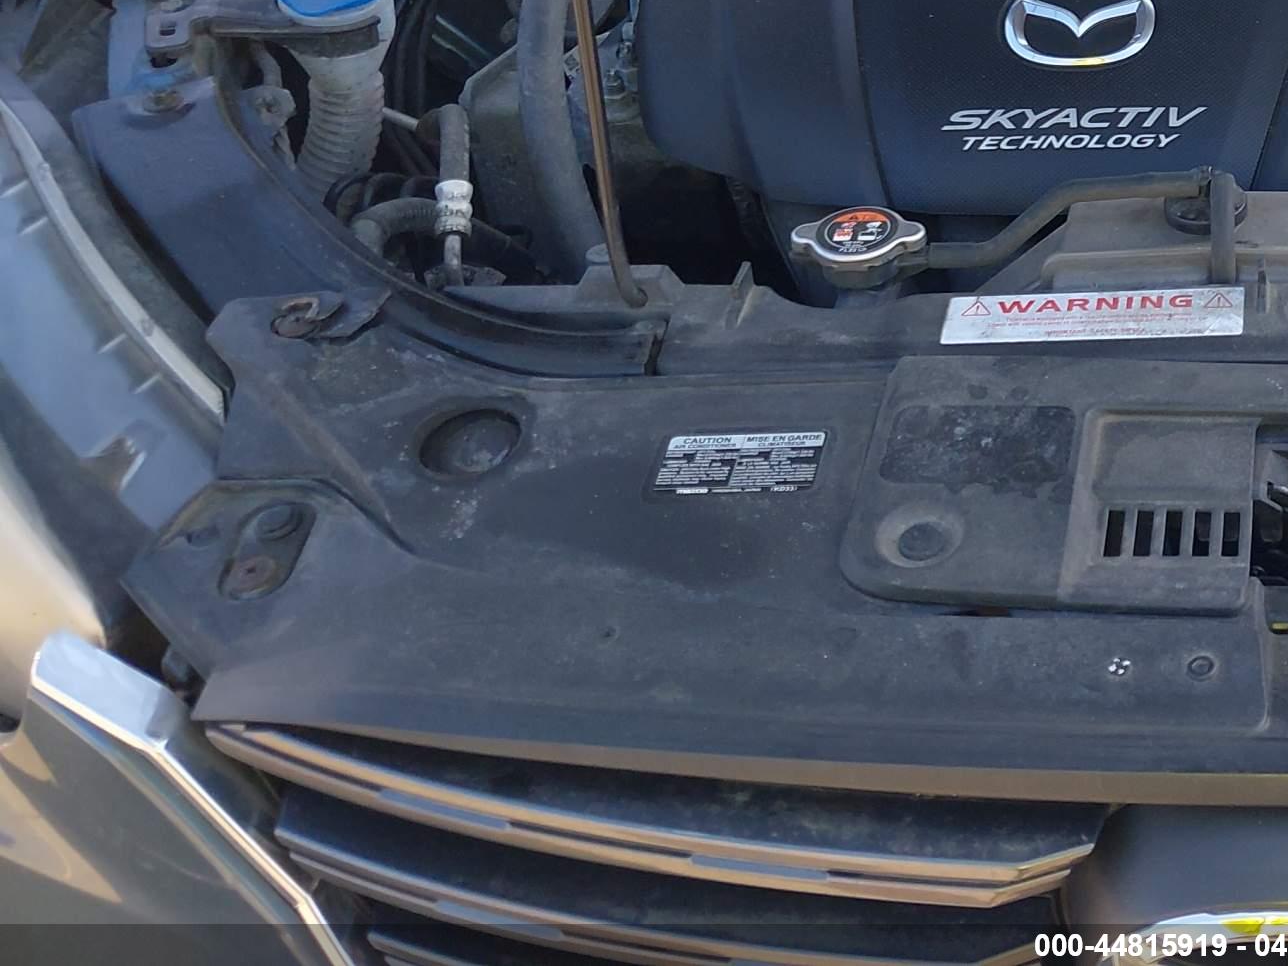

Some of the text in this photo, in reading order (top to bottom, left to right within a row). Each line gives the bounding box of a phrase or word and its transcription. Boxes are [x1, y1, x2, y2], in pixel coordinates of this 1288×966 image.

[941, 107, 1207, 131] SKYACTIV
[961, 133, 1180, 151] TECHNOLOGY
[998, 294, 1193, 314] WARNING
